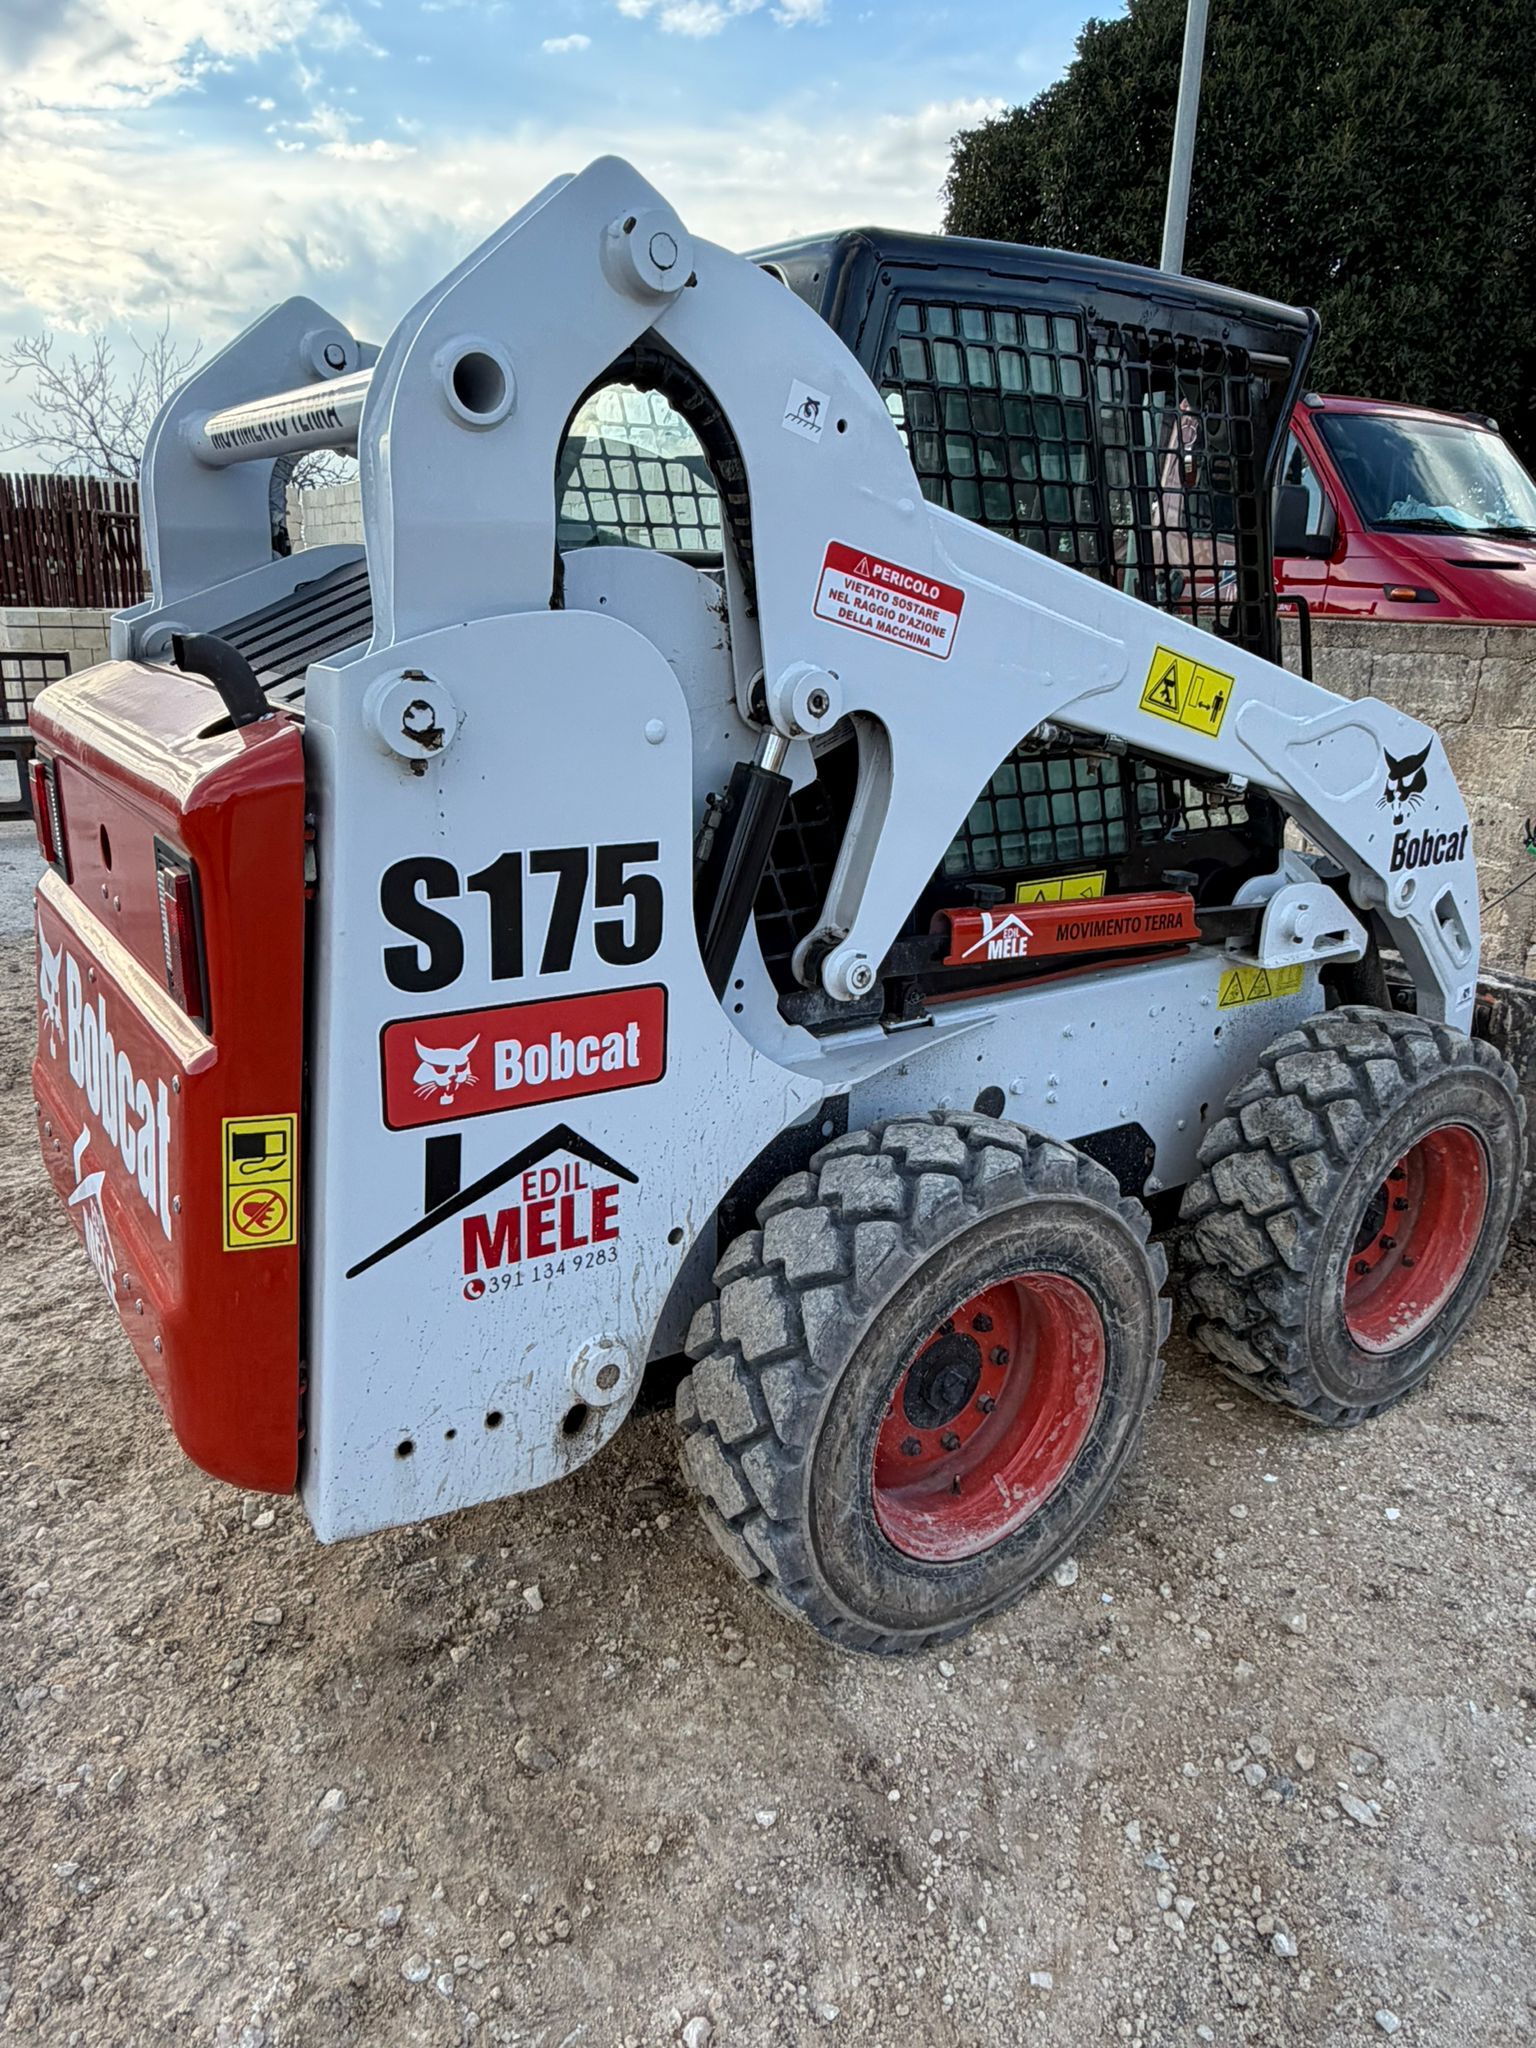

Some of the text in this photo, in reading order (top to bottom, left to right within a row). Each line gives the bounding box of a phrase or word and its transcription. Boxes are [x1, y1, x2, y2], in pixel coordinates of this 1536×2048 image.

[844, 577, 940, 622] VIETATO SOSTARE
[872, 563, 940, 600] PERICOLO
[828, 588, 947, 638] NEL RAGGIO D'AZIONE
[838, 607, 931, 648] DELLA MACCHINA
[1390, 824, 1468, 873] Bobcat
[380, 841, 664, 993] S175
[1002, 927, 1020, 939] EDIL
[1056, 912, 1183, 942] MOVIMENTO TERRA
[987, 935, 1028, 960] MELE
[494, 1021, 640, 1091] Bobcat
[66, 950, 172, 1242] Bobcat
[522, 1161, 589, 1202] EDIL
[462, 1184, 620, 1276] MELE
[489, 1246, 618, 1294] 391 134 9283
